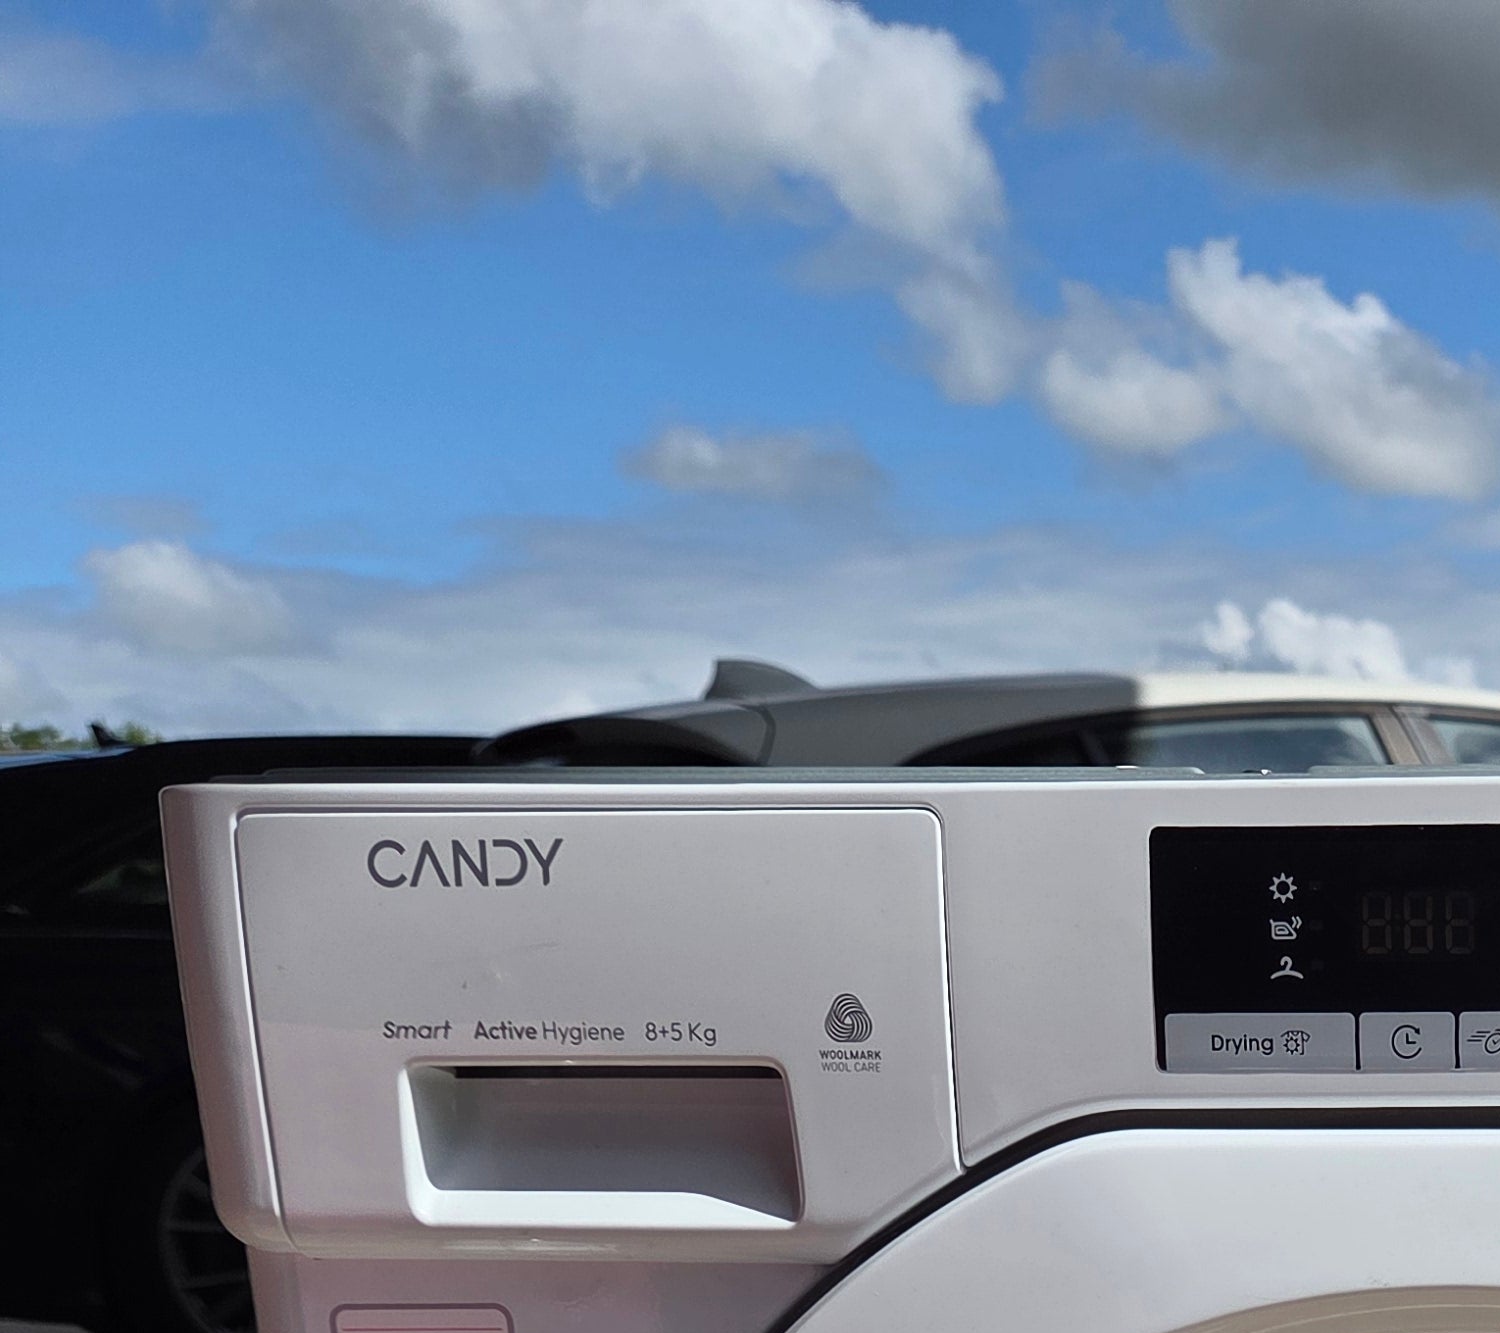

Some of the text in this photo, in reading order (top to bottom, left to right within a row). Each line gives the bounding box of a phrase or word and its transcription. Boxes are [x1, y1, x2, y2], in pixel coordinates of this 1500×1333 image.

[367, 838, 564, 889] CANDY
[382, 1021, 717, 1046] Smart Active Hygiene 8+5 Kg
[1211, 1032, 1275, 1056] Drying
[819, 1050, 882, 1061] WOOLMARK
[821, 1062, 881, 1073] WOOL CARE
